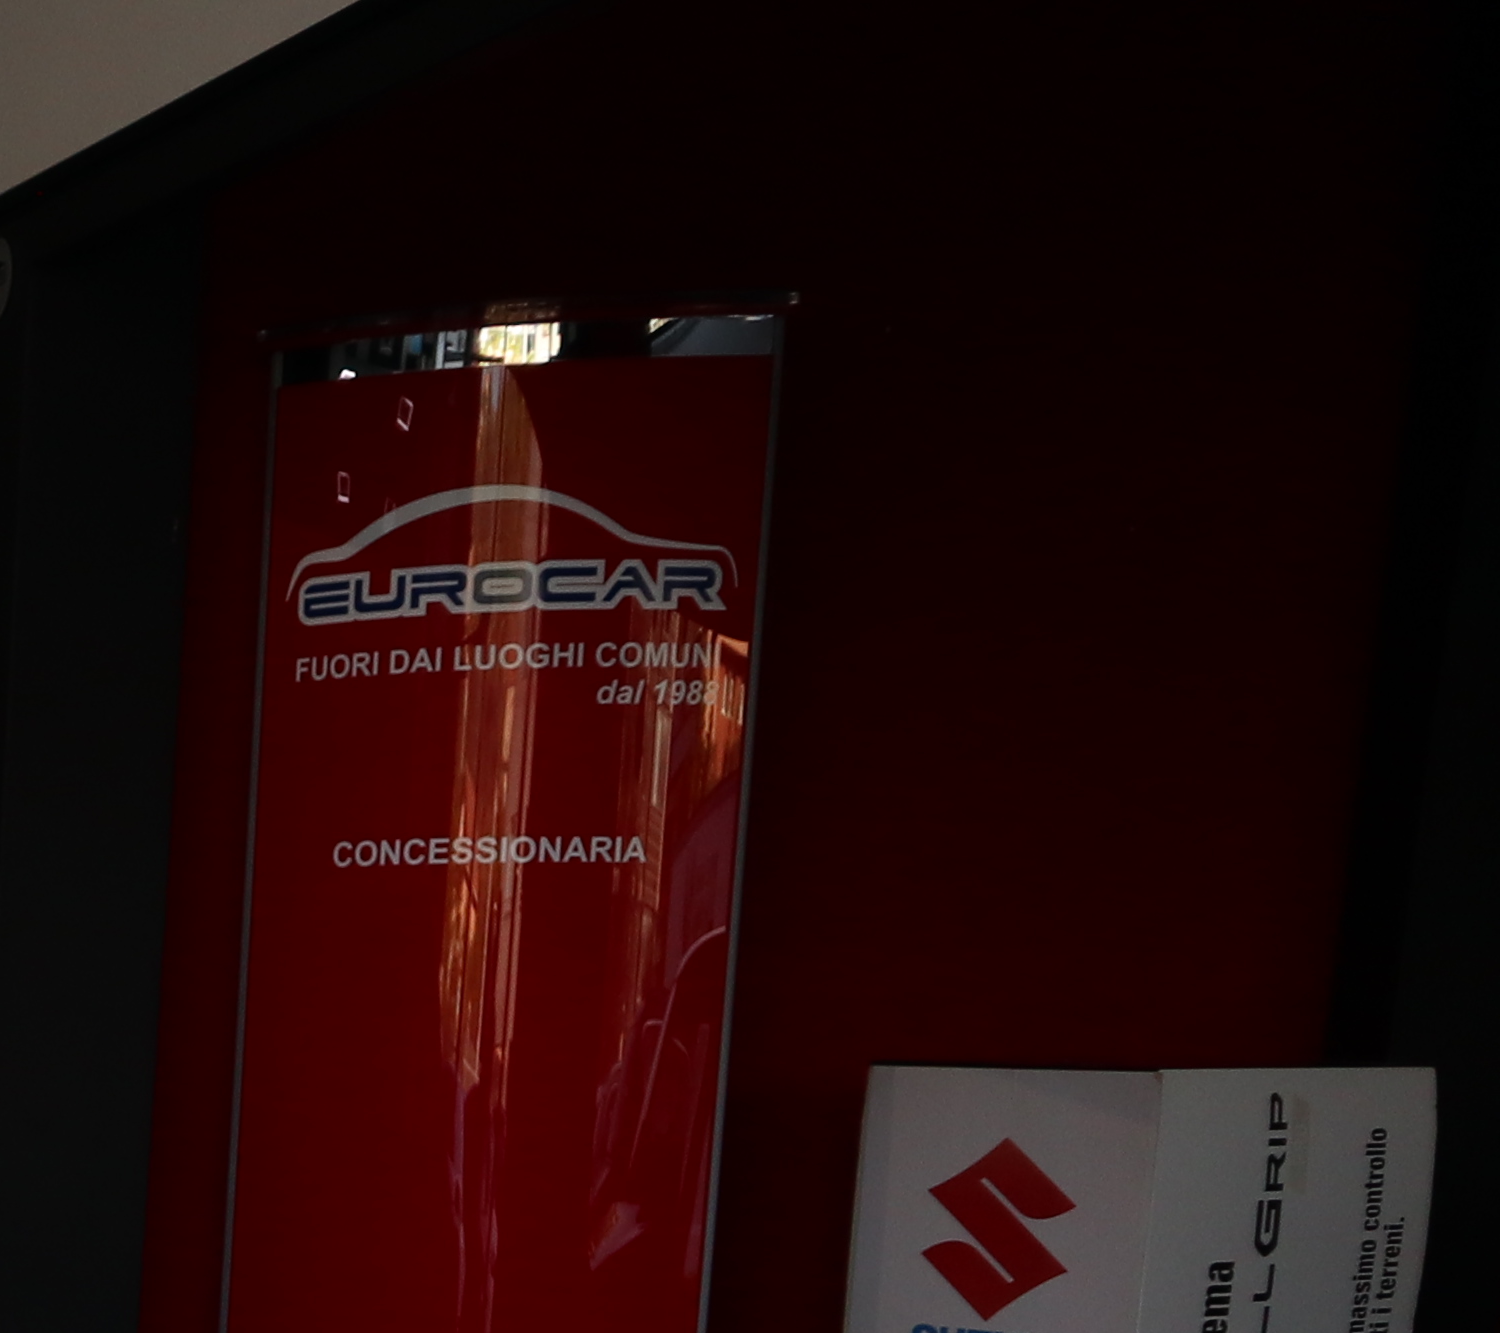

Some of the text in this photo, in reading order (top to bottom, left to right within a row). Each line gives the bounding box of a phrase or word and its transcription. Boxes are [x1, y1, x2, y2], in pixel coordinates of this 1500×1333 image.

[298, 559, 727, 626] EUROCAR
[295, 651, 379, 683] FUORI
[389, 646, 442, 675] DAI
[453, 642, 584, 672] LUOGHI
[596, 679, 720, 706] dal 1988
[333, 836, 646, 868] CONCESSIONARIA
[1364, 1127, 1388, 1232] controllo
[1376, 1216, 1405, 1300] terreni.
[1372, 1306, 1392, 1315] i
